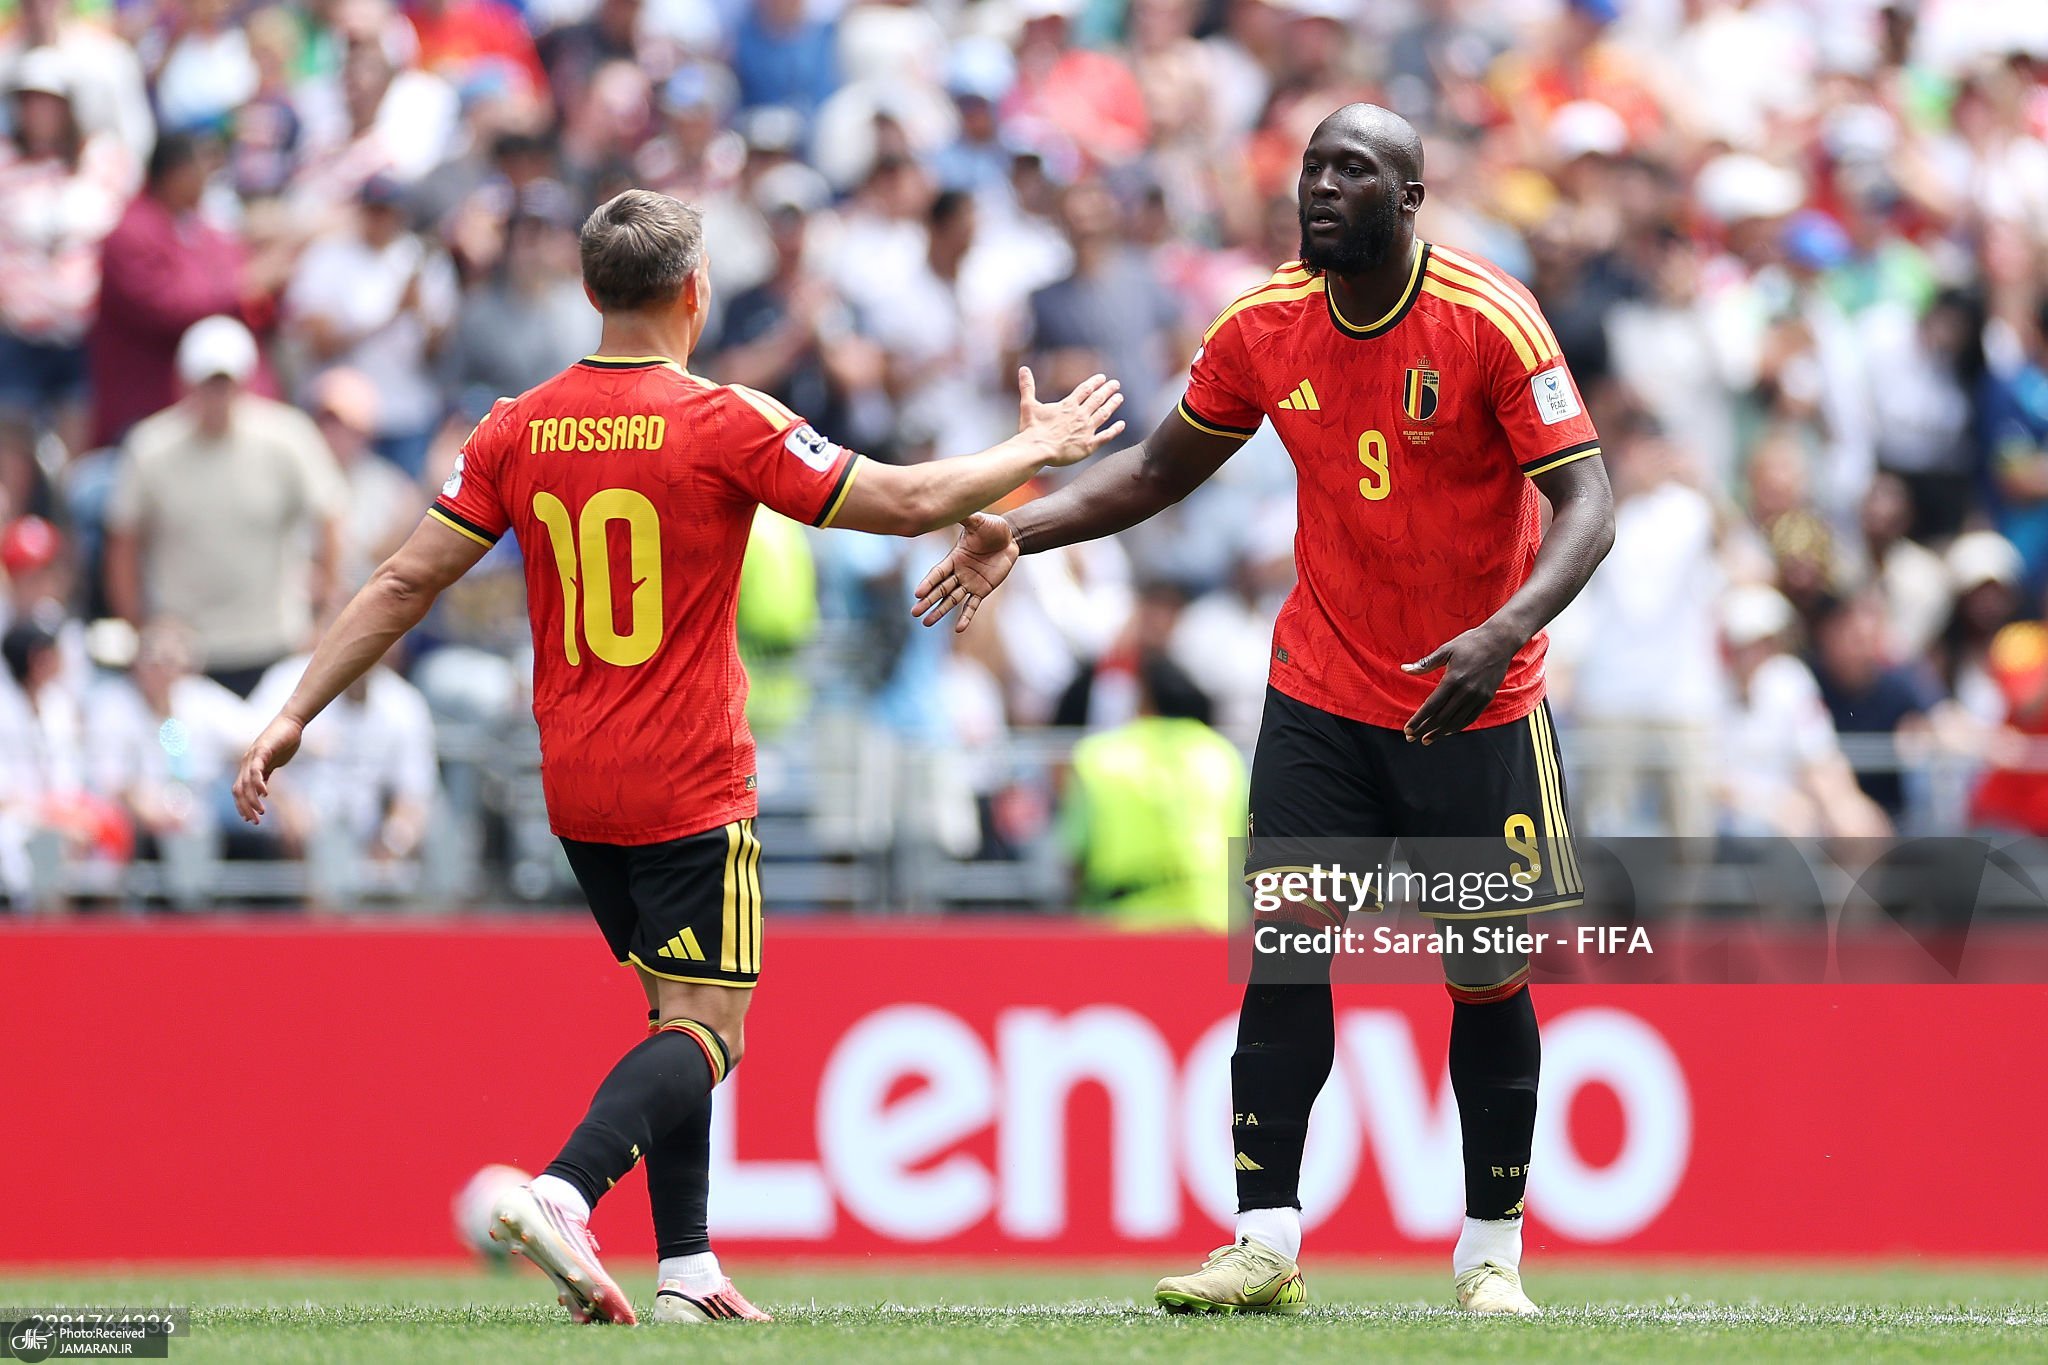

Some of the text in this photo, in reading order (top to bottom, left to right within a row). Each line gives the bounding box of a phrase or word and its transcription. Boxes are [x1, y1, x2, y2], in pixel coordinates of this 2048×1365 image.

[528, 414, 666, 455] TROSSARD
[1358, 429, 1391, 501] 9
[532, 488, 664, 667] 10
[1504, 813, 1541, 885] 9
[707, 1003, 1695, 1243] Lenovo
